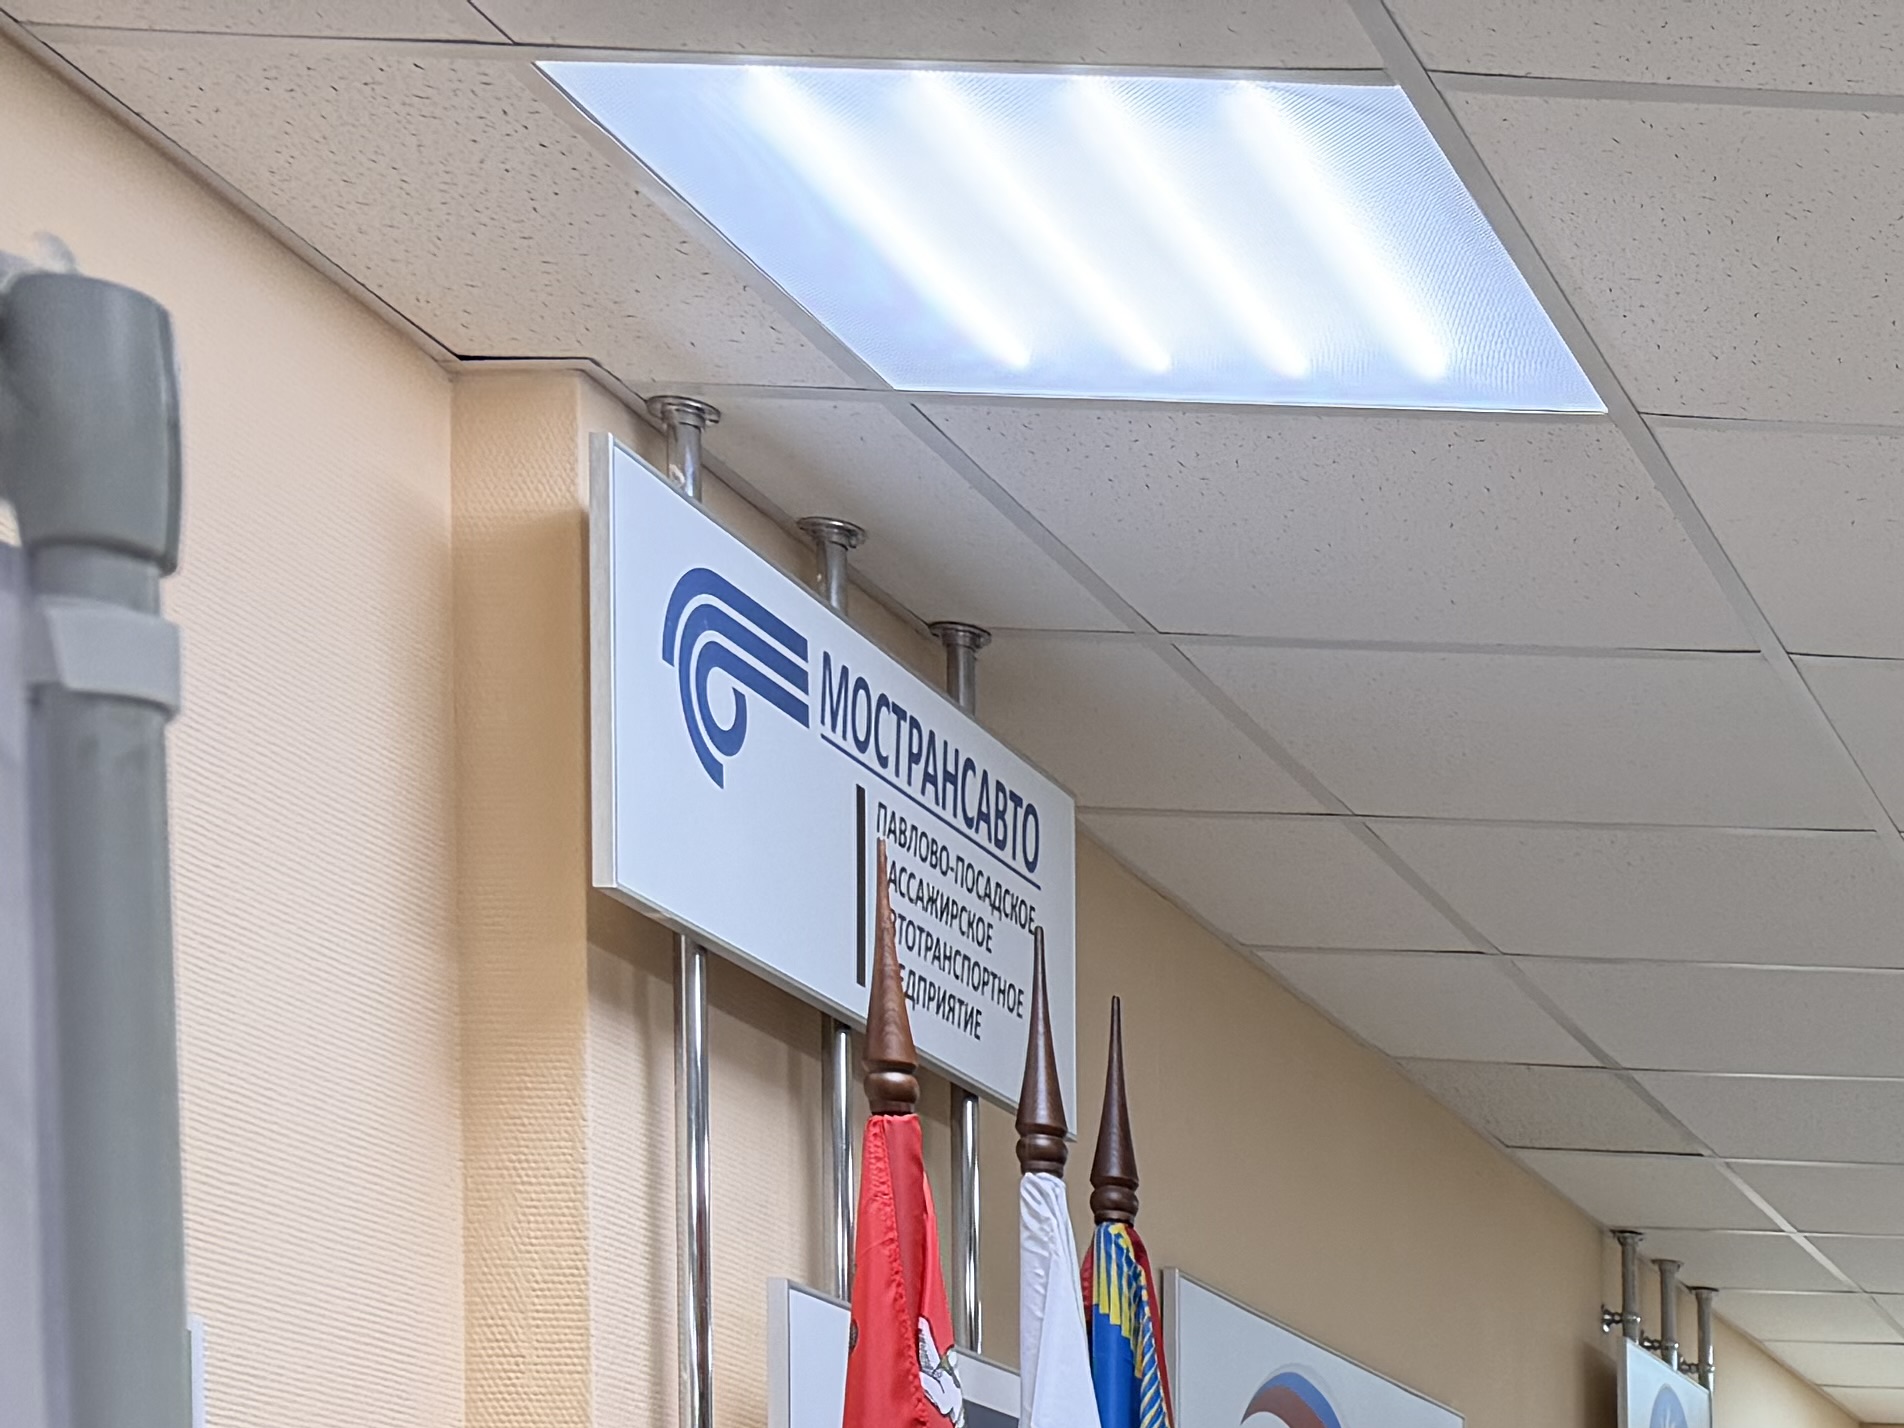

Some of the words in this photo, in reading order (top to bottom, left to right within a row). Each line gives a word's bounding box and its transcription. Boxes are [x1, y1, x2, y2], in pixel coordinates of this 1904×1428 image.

[820, 650, 1040, 874] МОСТРАНСАВТО
[876, 801, 1036, 936] ПАВЛОВО-ПОСАДСКОЕ
[887, 860, 994, 954] АССАЖИРСКОЕ
